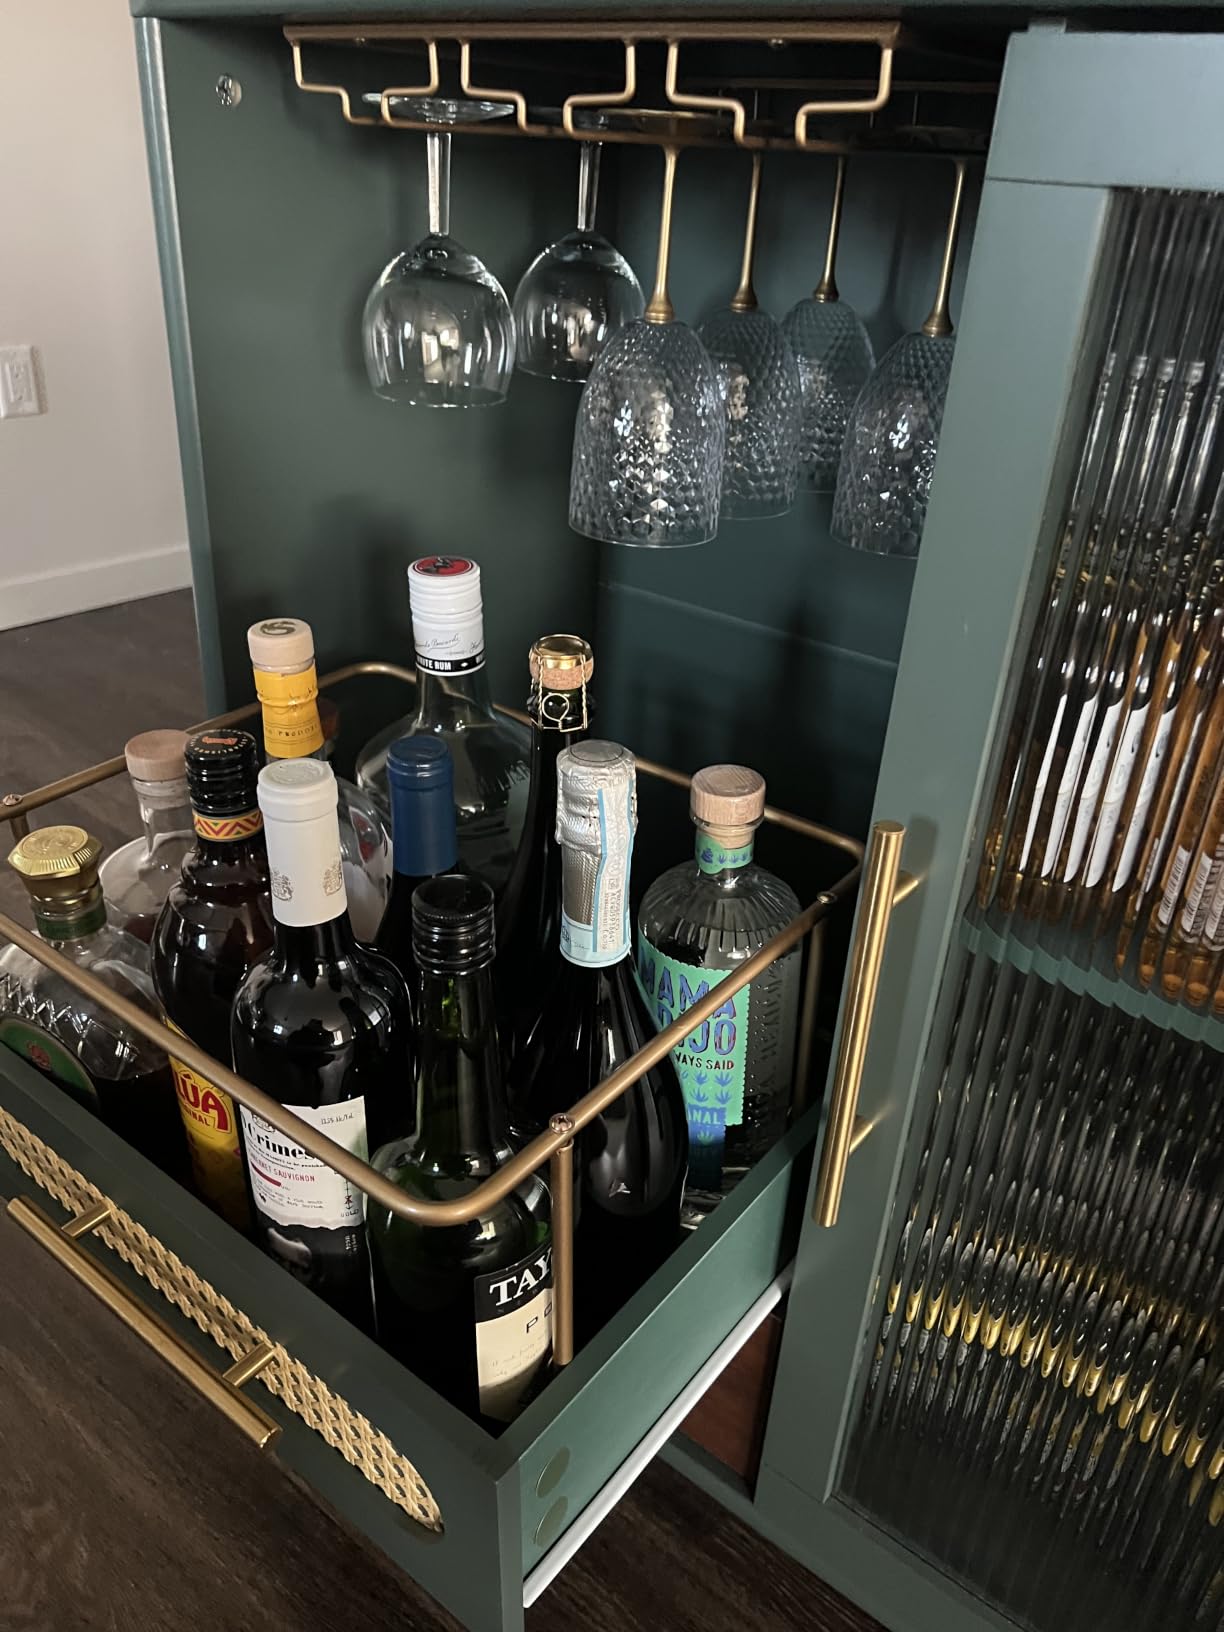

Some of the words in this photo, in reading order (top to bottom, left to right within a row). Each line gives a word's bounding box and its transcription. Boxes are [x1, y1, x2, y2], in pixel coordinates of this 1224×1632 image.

[434, 660, 452, 671] RUM
[657, 1001, 737, 1056] DJO
[706, 1060, 735, 1070] SAID
[247, 1122, 315, 1161] Crime
[273, 1168, 315, 1183] SAUVIGNON
[489, 1247, 552, 1306] TAY
